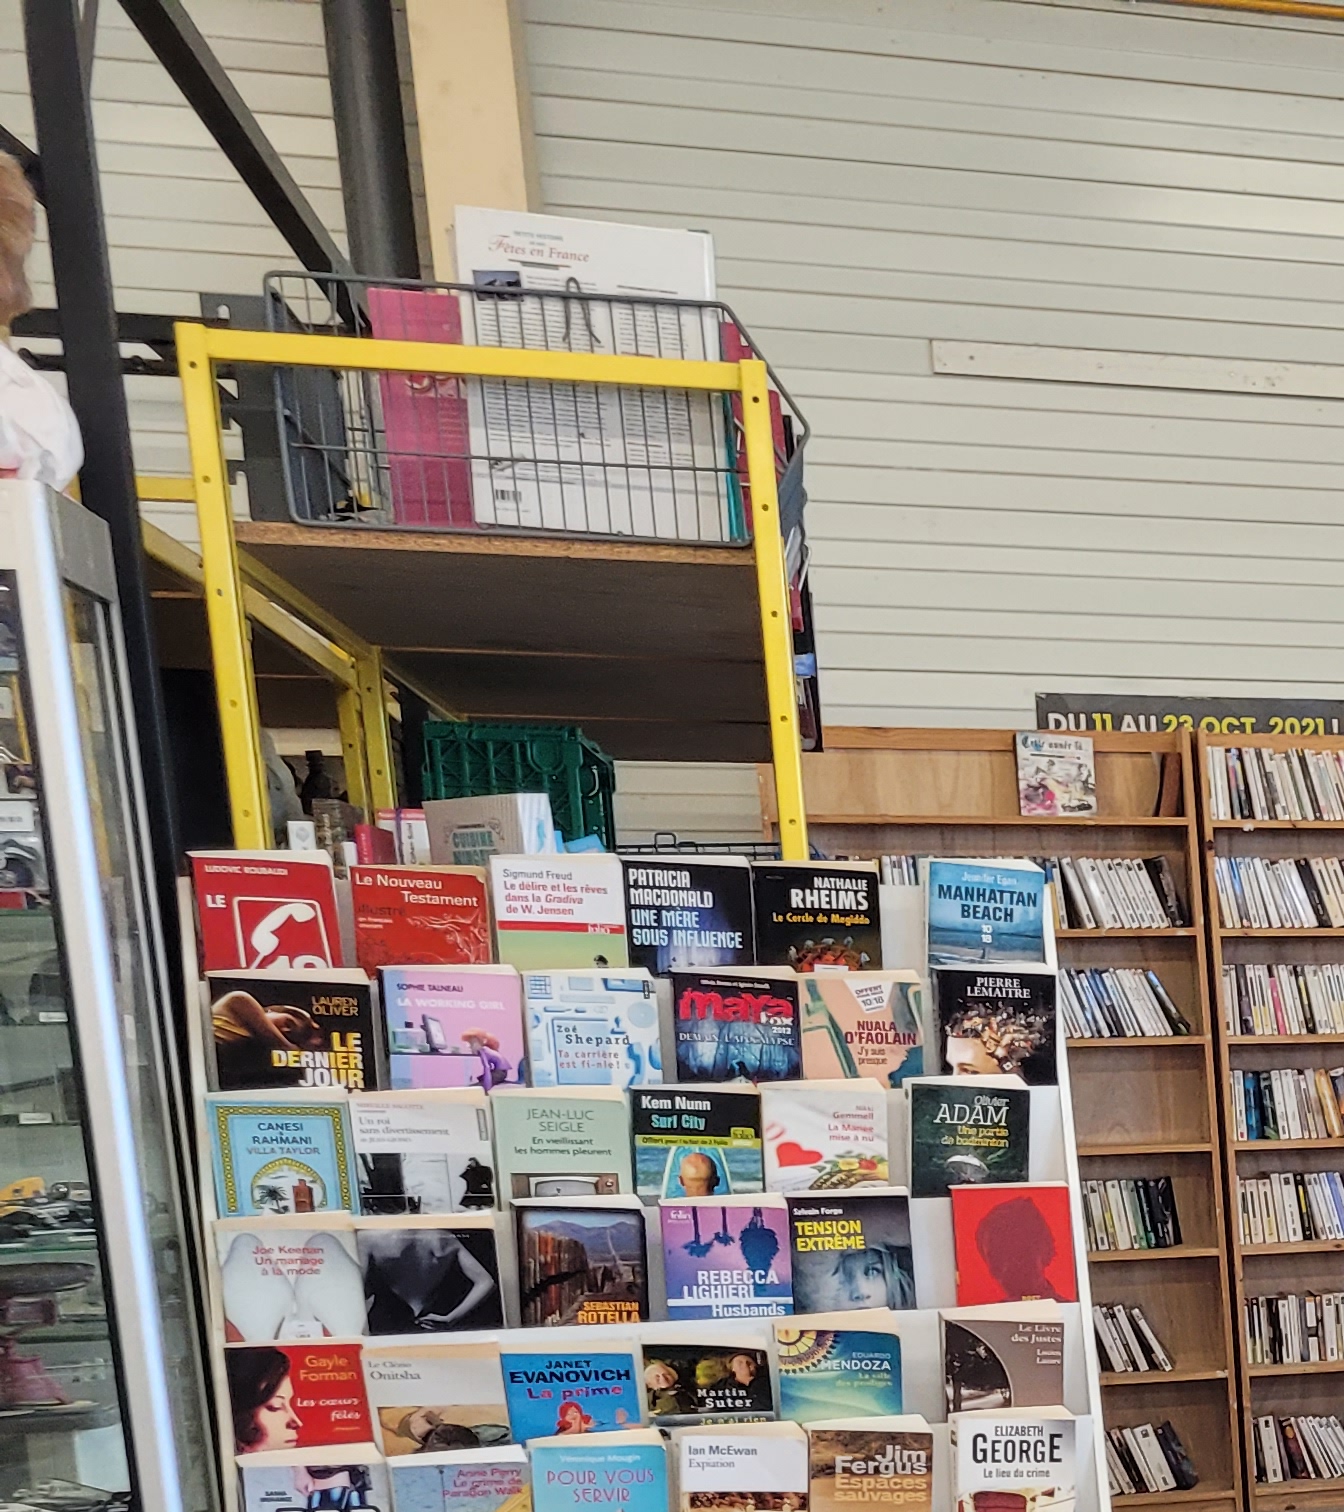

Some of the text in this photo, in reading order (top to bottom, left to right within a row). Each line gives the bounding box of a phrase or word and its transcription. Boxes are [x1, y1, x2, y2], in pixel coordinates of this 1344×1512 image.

[1048, 712, 1086, 732] DU
[1092, 713, 1112, 732] 11
[1120, 713, 1157, 733] AU
[1162, 714, 1195, 732] 23
[1268, 717, 1325, 736] 2021
[356, 872, 443, 891] Le Nouveau
[503, 869, 573, 881] Sigmund Freud
[628, 868, 690, 888] PATRICIA
[813, 876, 868, 891] NATHALIE
[206, 894, 227, 909] LE
[400, 890, 479, 908] Testament
[629, 887, 713, 909] MACDONALD
[790, 888, 869, 910] RHEIMS
[937, 884, 1037, 907] MANHATTAN
[536, 904, 574, 916] Jensen
[630, 906, 700, 928] UNE MÈRE
[960, 904, 1014, 923] BEACH
[631, 928, 743, 949] SOUS INFLUENCE
[976, 976, 1021, 989] PIERRE
[312, 1006, 359, 1017] OLIVER
[857, 1020, 897, 1033] NUALA
[331, 1032, 362, 1052] LE
[565, 1034, 630, 1048] Shepard
[844, 1030, 917, 1046] O'FAOLAIN
[271, 1050, 363, 1069] DERNIER
[298, 1068, 365, 1088] JOUR
[641, 1095, 712, 1111] Kem Nunn
[526, 1109, 595, 1121] JEAN-LUC
[833, 1111, 874, 1120] Gemmell
[933, 1104, 1008, 1126] ADAM
[258, 1122, 304, 1132] CANESI
[539, 1121, 585, 1133] SEIGLE
[681, 1115, 706, 1131] City
[252, 1135, 312, 1146] RAHMANI
[546, 1137, 594, 1146] vieillissant
[531, 1147, 612, 1157] hommes pleurent
[795, 1220, 862, 1235] TENSION
[796, 1233, 866, 1253] EXTRÊME
[278, 1246, 324, 1256] Keenan
[254, 1256, 324, 1268] Un mariage
[286, 1267, 321, 1276] mode
[697, 1271, 779, 1286] REBECCA
[683, 1286, 754, 1300] LIGHIERI
[583, 1301, 639, 1312] SEBASTIAN
[711, 1303, 786, 1318] Husbands
[578, 1311, 640, 1324] ROTELLA
[1035, 1324, 1062, 1334] Livre
[1030, 1333, 1062, 1344] Justes
[305, 1355, 348, 1369] Gayle
[545, 1360, 592, 1370] JANET
[820, 1359, 892, 1371] MENDOZA
[299, 1369, 357, 1382] Forman
[369, 1369, 421, 1382] Onitsha
[510, 1368, 631, 1384] EVANOVICH
[527, 1385, 623, 1400] La prime
[697, 1388, 748, 1398] Martin
[705, 1397, 753, 1409] Suter
[994, 1425, 1044, 1438] ELIZABETH
[688, 1444, 758, 1456] Ian McEwan
[875, 1444, 927, 1464] Jim
[972, 1432, 1063, 1464] GEORGE
[688, 1459, 735, 1471] Expiation
[835, 1456, 928, 1479] Fergus
[491, 1468, 522, 1479] Perry
[547, 1468, 655, 1485] POUR VOUS
[835, 1477, 928, 1493] Espaces
[573, 1488, 631, 1503] SERVIR
[834, 1490, 928, 1505] sauvages
